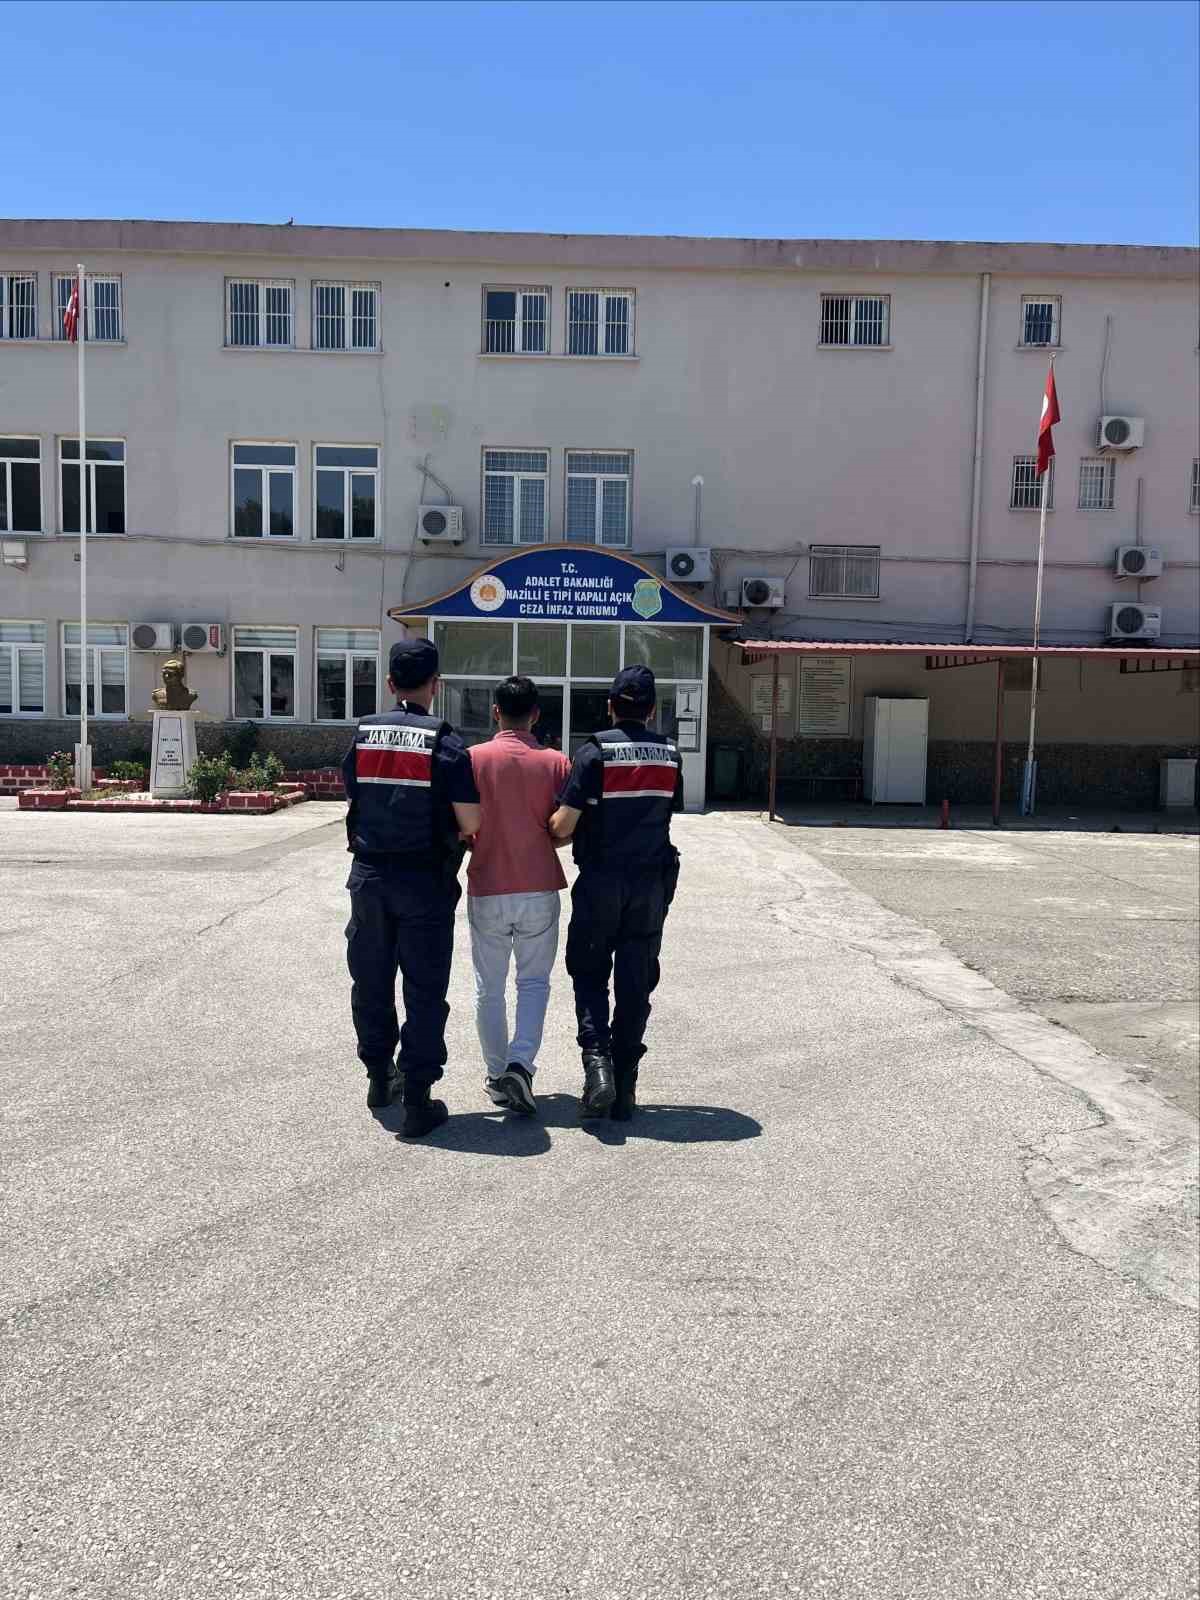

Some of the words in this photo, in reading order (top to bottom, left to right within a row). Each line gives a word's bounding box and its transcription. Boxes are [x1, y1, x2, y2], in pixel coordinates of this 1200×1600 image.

[560, 563, 578, 573] T.C.
[525, 576, 561, 587] ADALET
[563, 576, 613, 588] BAKANLIĞI
[506, 588, 541, 600] NAZİLLİ
[544, 591, 550, 600] E
[575, 591, 607, 602] KAPALI
[610, 592, 633, 604] AÇIK
[519, 603, 544, 614] CEZA
[546, 602, 574, 615] İNFAZ
[577, 605, 618, 616] KURUMU
[365, 729, 425, 748] JANDARMA
[612, 744, 671, 761] JANDARMA
